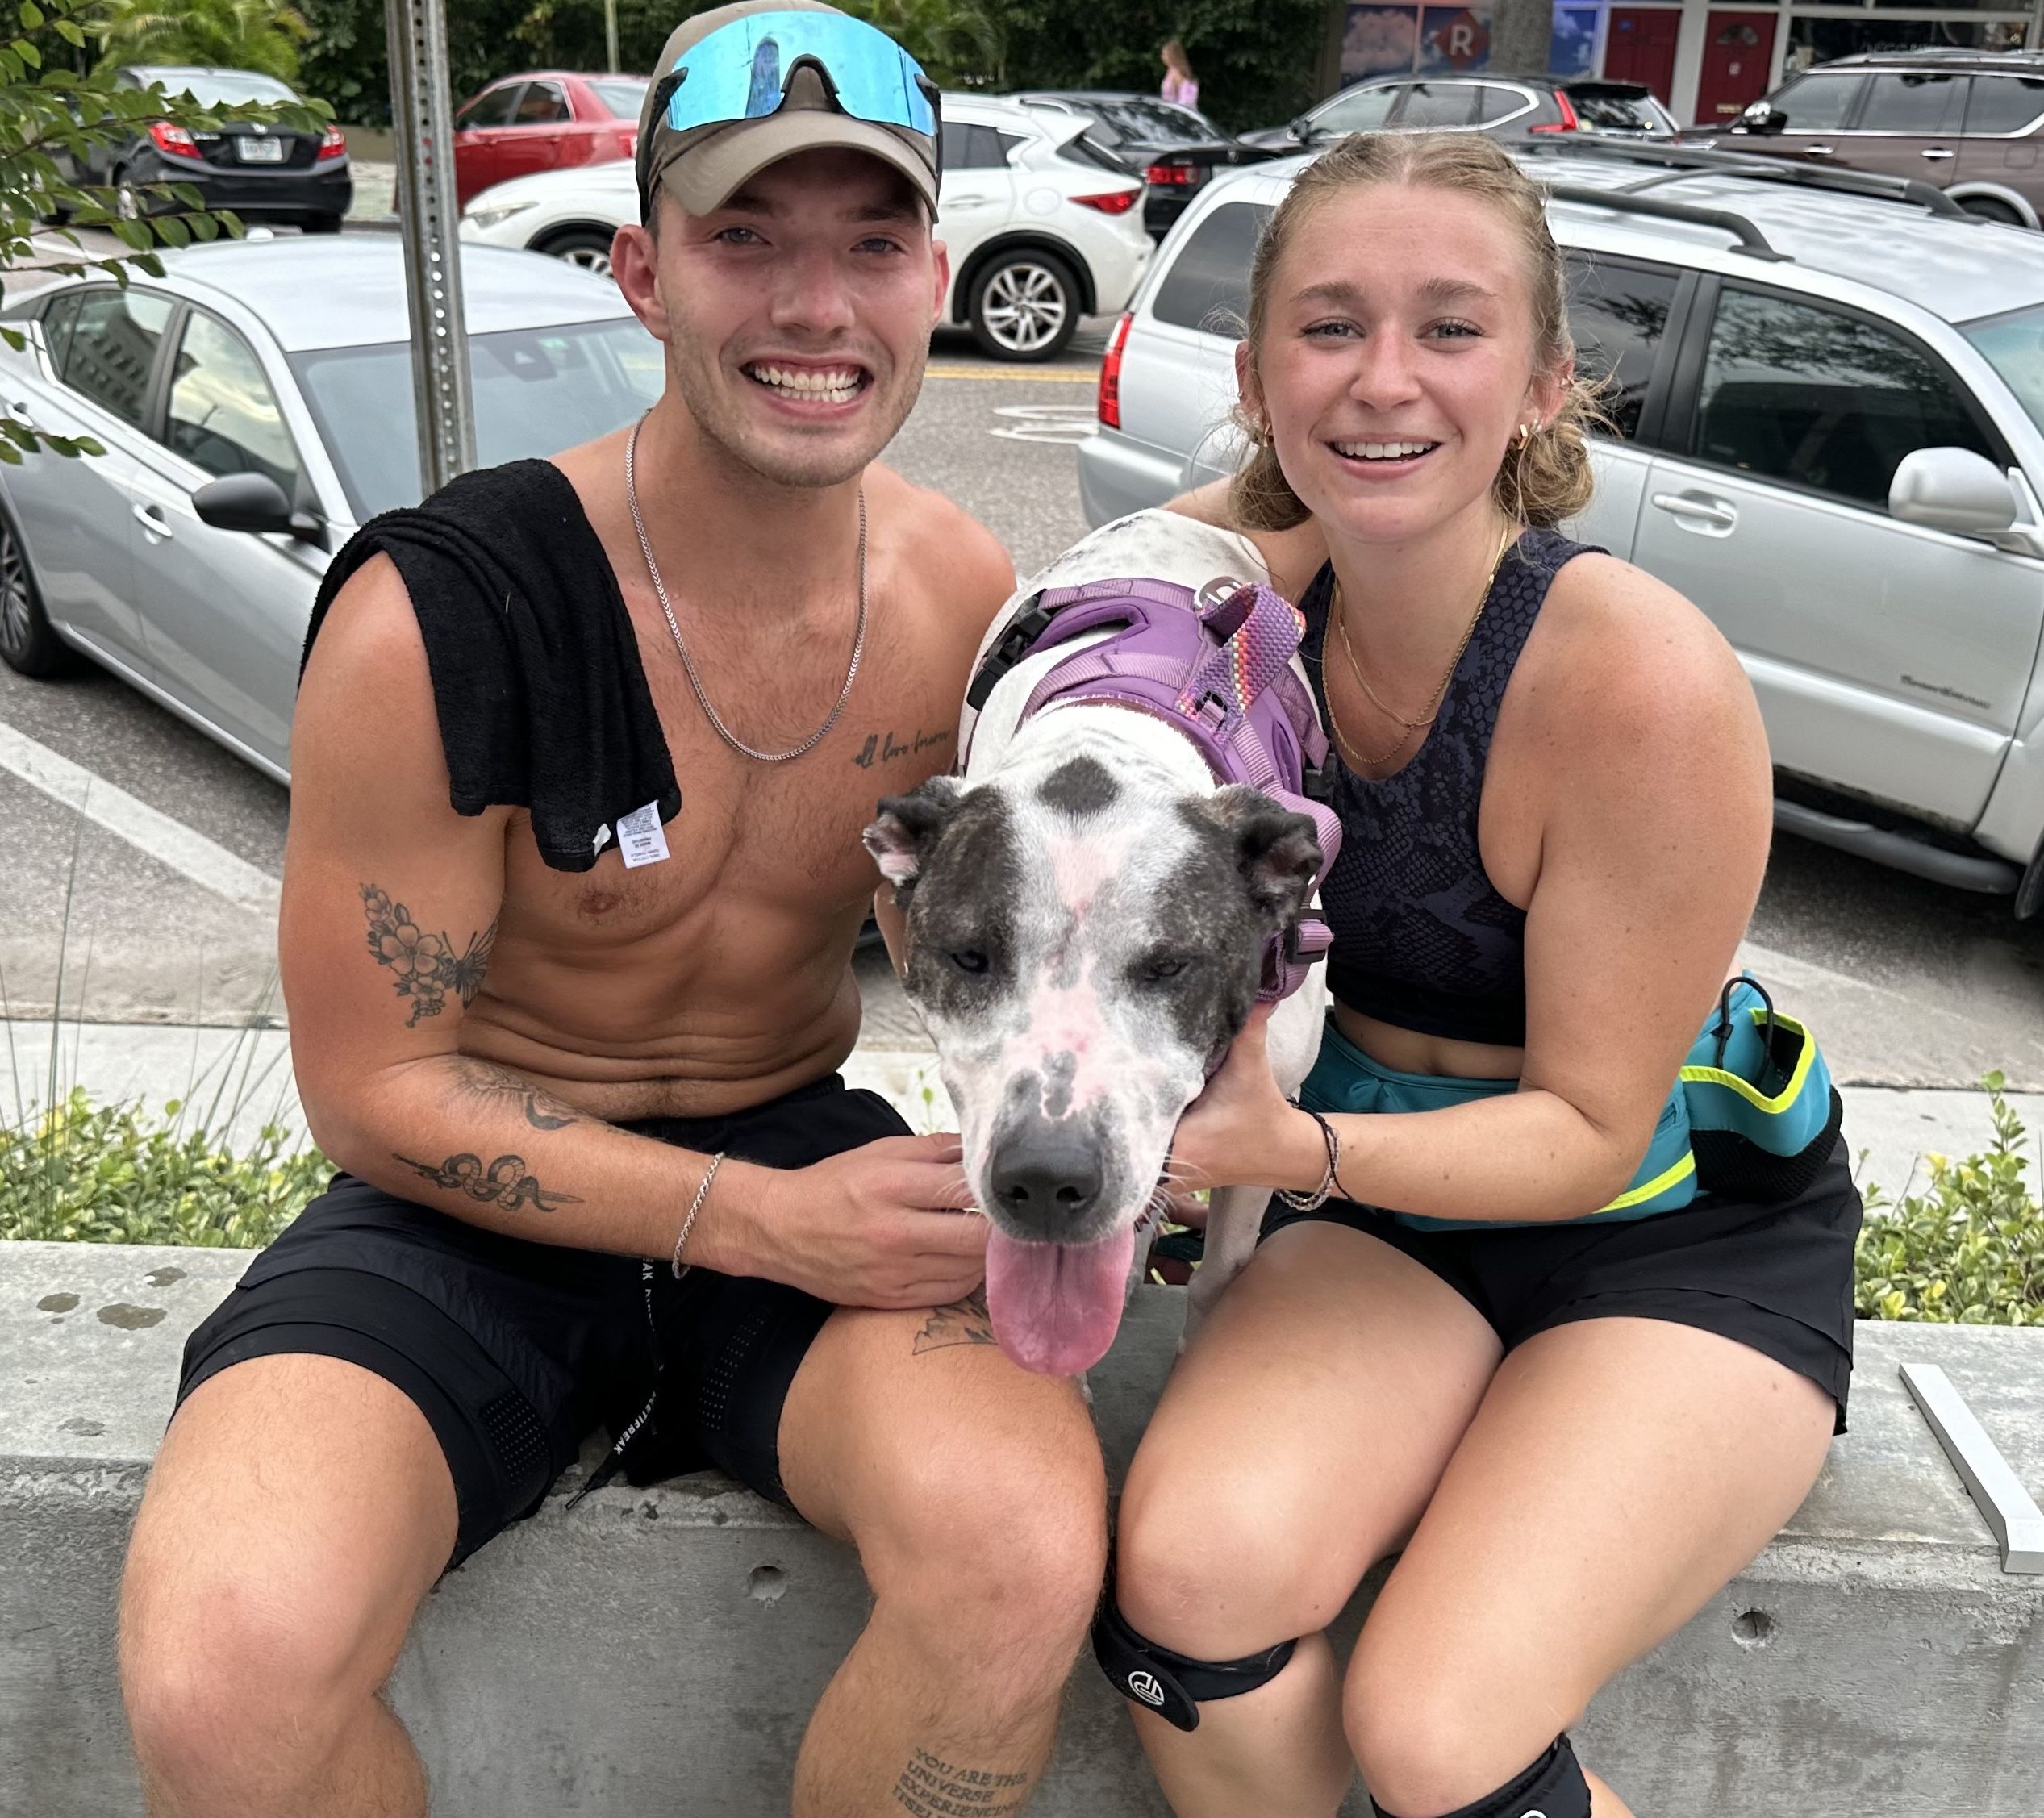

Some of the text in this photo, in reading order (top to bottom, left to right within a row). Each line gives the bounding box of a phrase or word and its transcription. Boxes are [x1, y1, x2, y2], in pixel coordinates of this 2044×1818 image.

[1449, 24, 1474, 57] R
[907, 1760, 995, 1803] UNIVERSE
[916, 1746, 1028, 1787] YOU ARE THE
